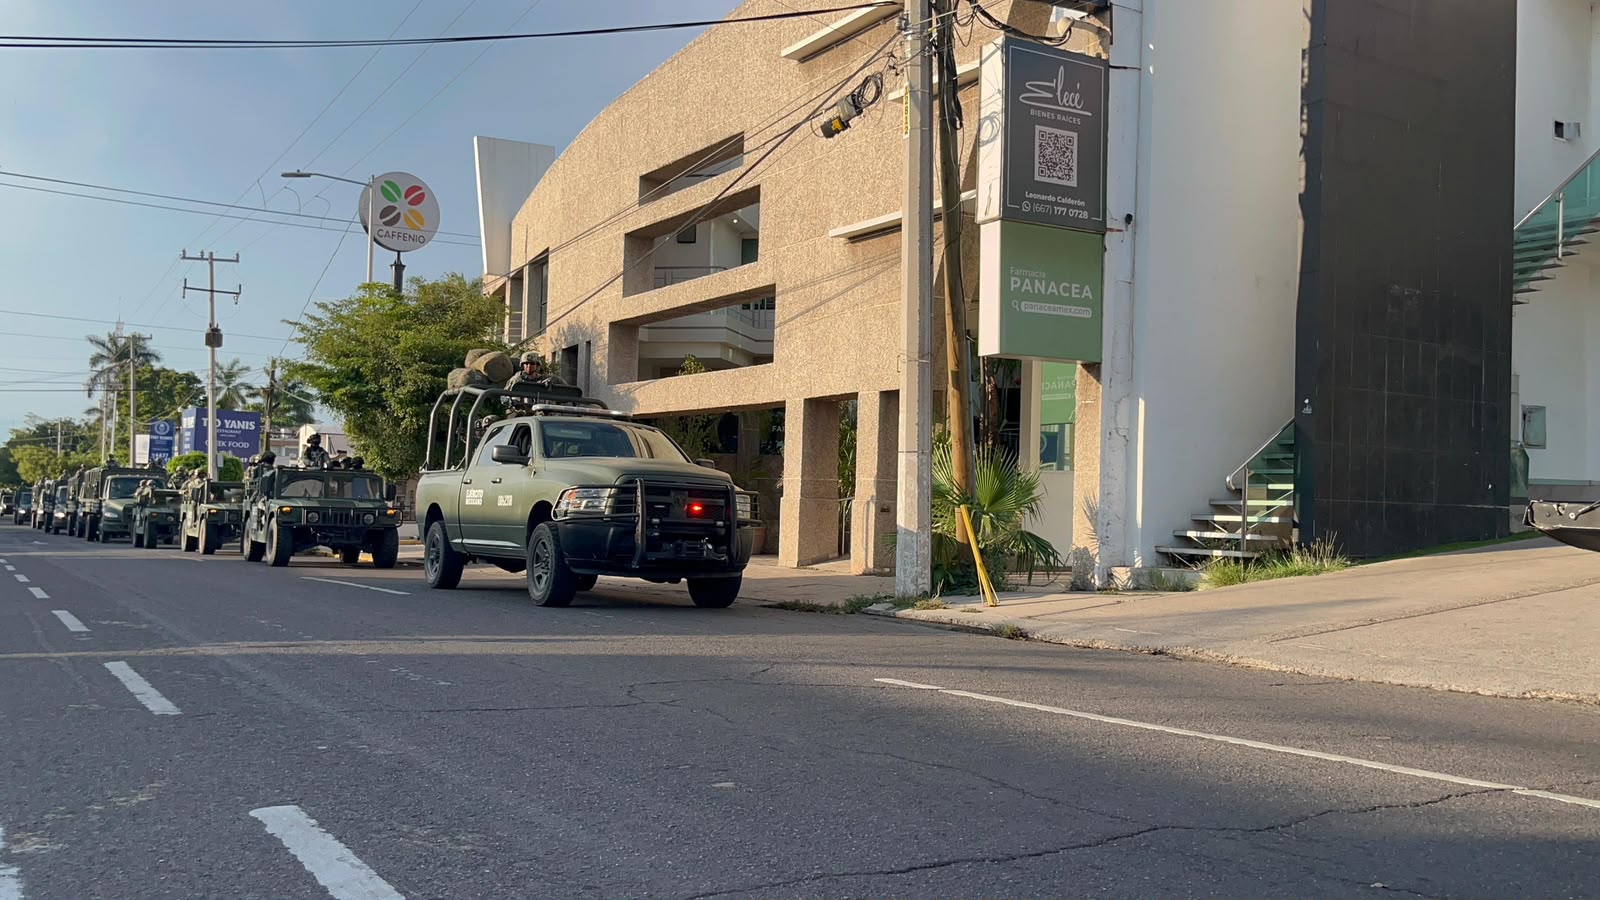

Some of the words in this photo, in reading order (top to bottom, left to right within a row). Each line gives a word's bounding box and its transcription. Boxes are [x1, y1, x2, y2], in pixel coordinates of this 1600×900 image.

[1030, 108, 1055, 119] BIENES
[1025, 191, 1056, 202] Leonardo
[1057, 196, 1086, 207] Calderón
[1032, 203, 1052, 215] (667)
[1053, 206, 1067, 216] 177
[1068, 209, 1089, 219] 0728
[377, 229, 425, 243] CAFFENIO
[1010, 266, 1046, 278] Farmacia
[1010, 276, 1093, 300] PANACEA
[1024, 303, 1090, 316] panaceamex.com
[202, 417, 222, 428] TO
[224, 420, 255, 430] YANIS
[228, 440, 250, 449] FOOD
